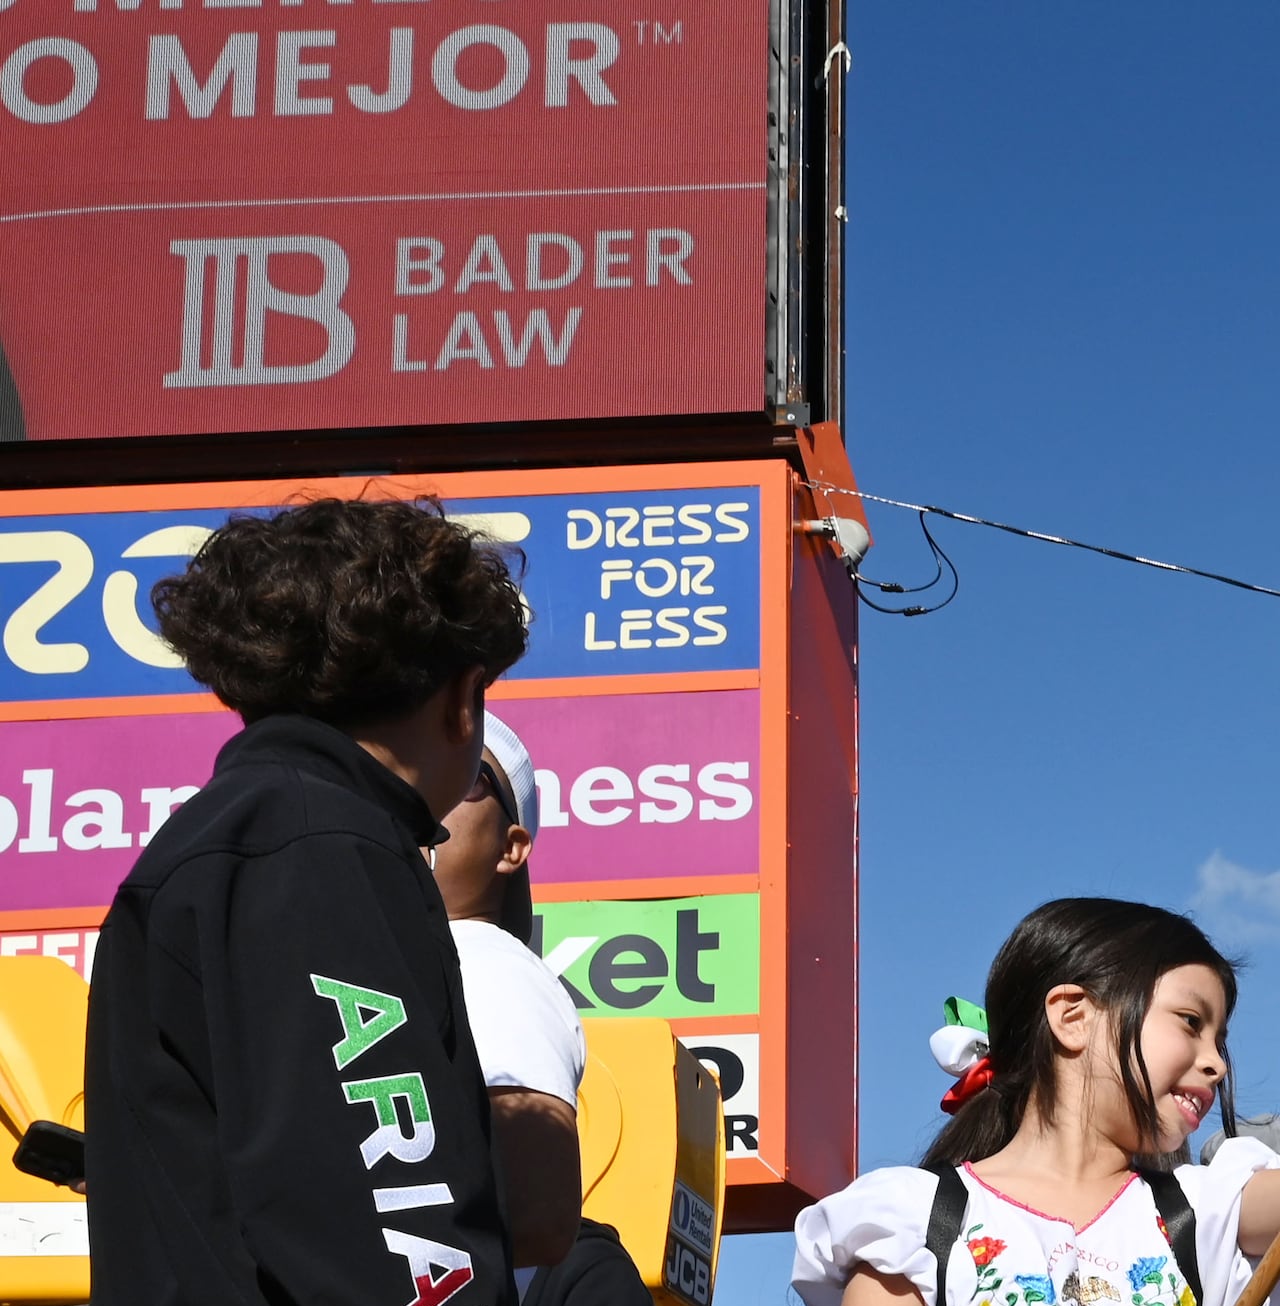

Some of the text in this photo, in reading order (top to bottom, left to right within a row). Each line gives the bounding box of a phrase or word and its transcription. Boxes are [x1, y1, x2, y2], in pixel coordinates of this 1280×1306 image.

[144, 22, 621, 121] MEJOR
[393, 228, 696, 296] BADER
[391, 307, 583, 374] LAW
[566, 502, 750, 550] DRESS
[600, 556, 715, 600] FOR
[584, 606, 727, 651] LESS
[688, 1219, 712, 1249] Rentals
[691, 1200, 713, 1229] United
[666, 1243, 710, 1305] JCB
